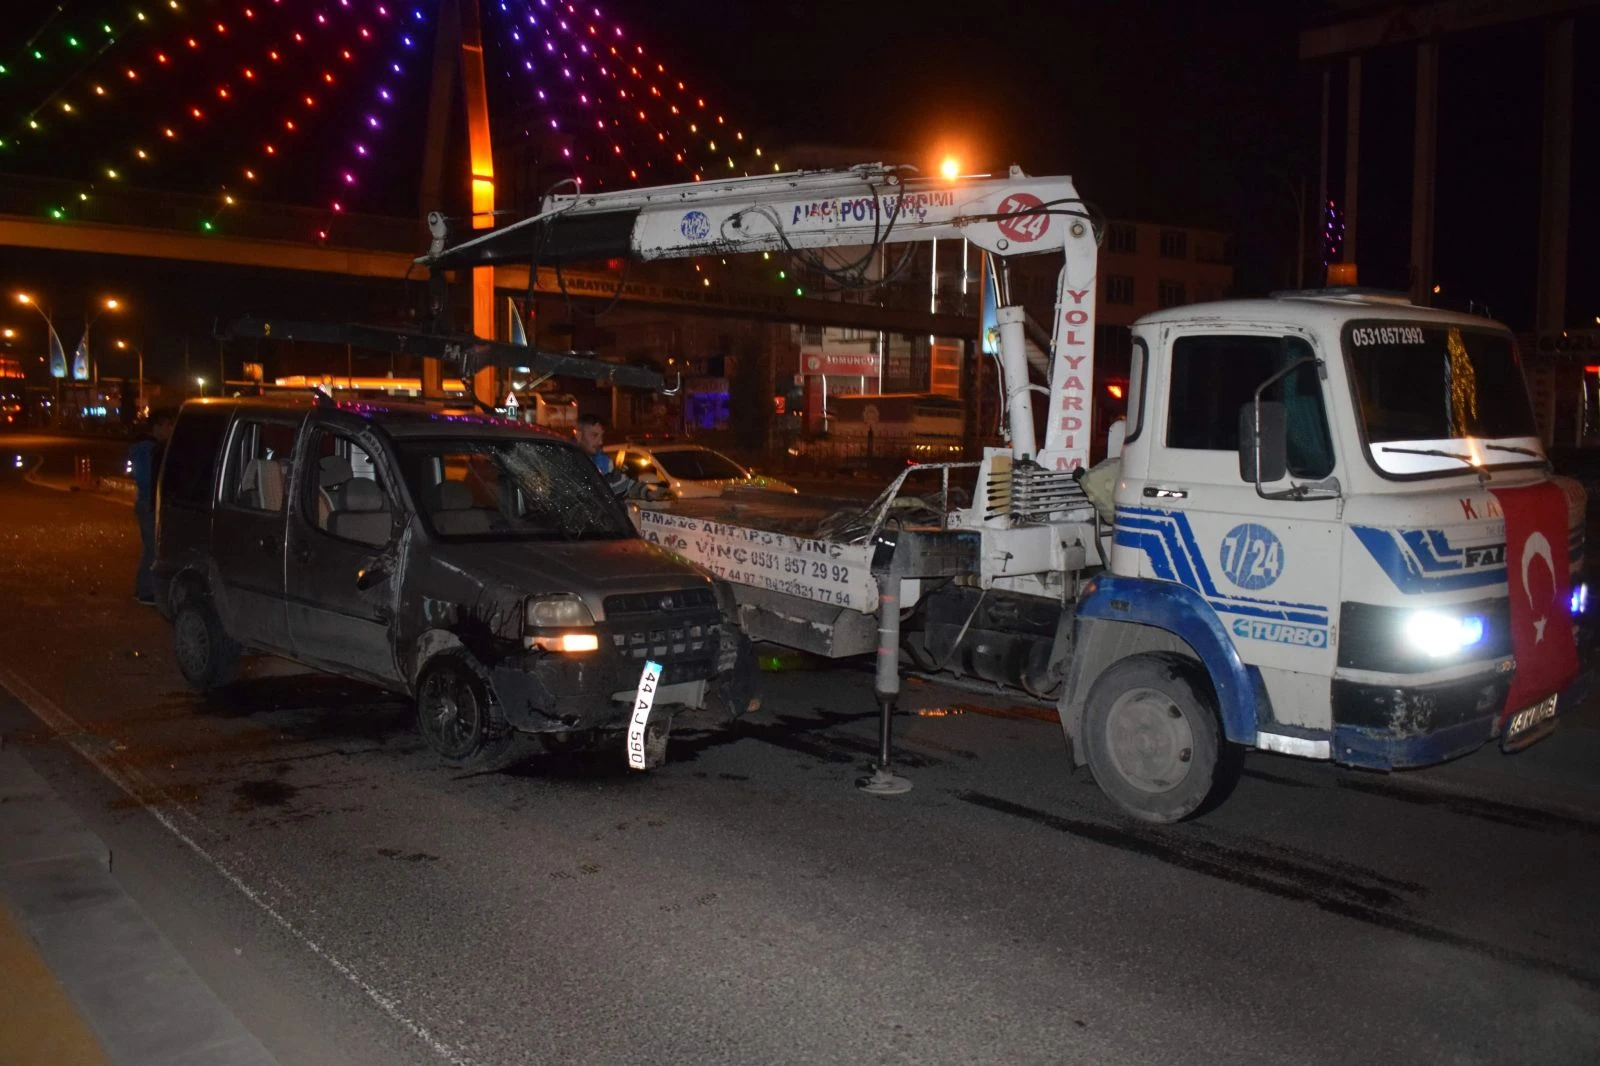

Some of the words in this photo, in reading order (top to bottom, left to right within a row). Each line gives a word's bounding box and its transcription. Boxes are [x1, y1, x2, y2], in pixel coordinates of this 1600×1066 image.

[1064, 289, 1089, 345] YOL
[1352, 327, 1425, 347] 05318572992
[1055, 355, 1087, 472] YARDIM
[750, 550, 780, 571] 0531
[784, 555, 808, 576] 857
[811, 561, 828, 580] 29
[831, 564, 849, 584] 92
[1223, 525, 1282, 583] 7/24
[728, 569, 742, 581] 44
[818, 588, 832, 602] 77
[1252, 620, 1326, 648] TURBO
[642, 671, 656, 694] 44
[633, 698, 649, 726] AJ
[630, 730, 644, 764] 590
